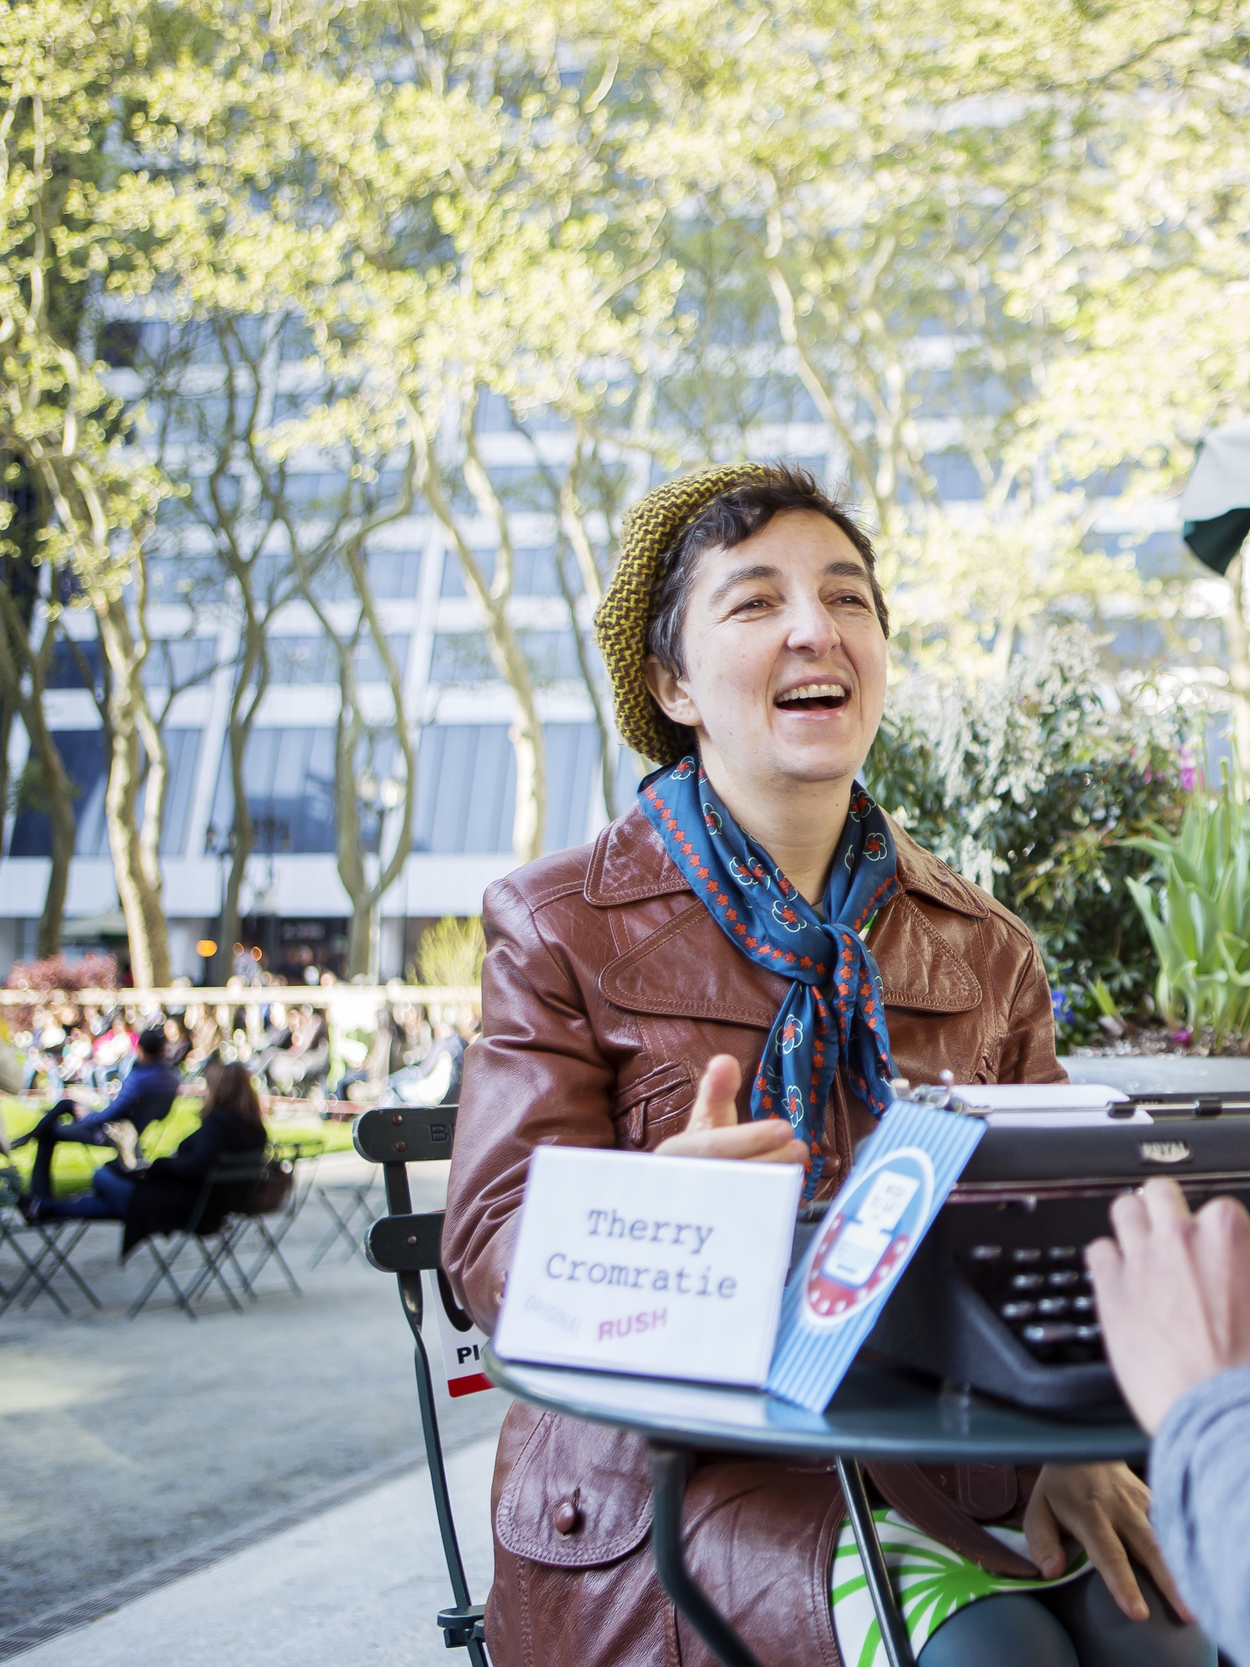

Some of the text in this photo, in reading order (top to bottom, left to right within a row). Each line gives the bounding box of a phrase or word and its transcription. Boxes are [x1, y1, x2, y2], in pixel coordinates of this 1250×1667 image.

[588, 1208, 714, 1255] Therry
[545, 1252, 738, 1299] Cromratie
[598, 1307, 667, 1342] RUSH
